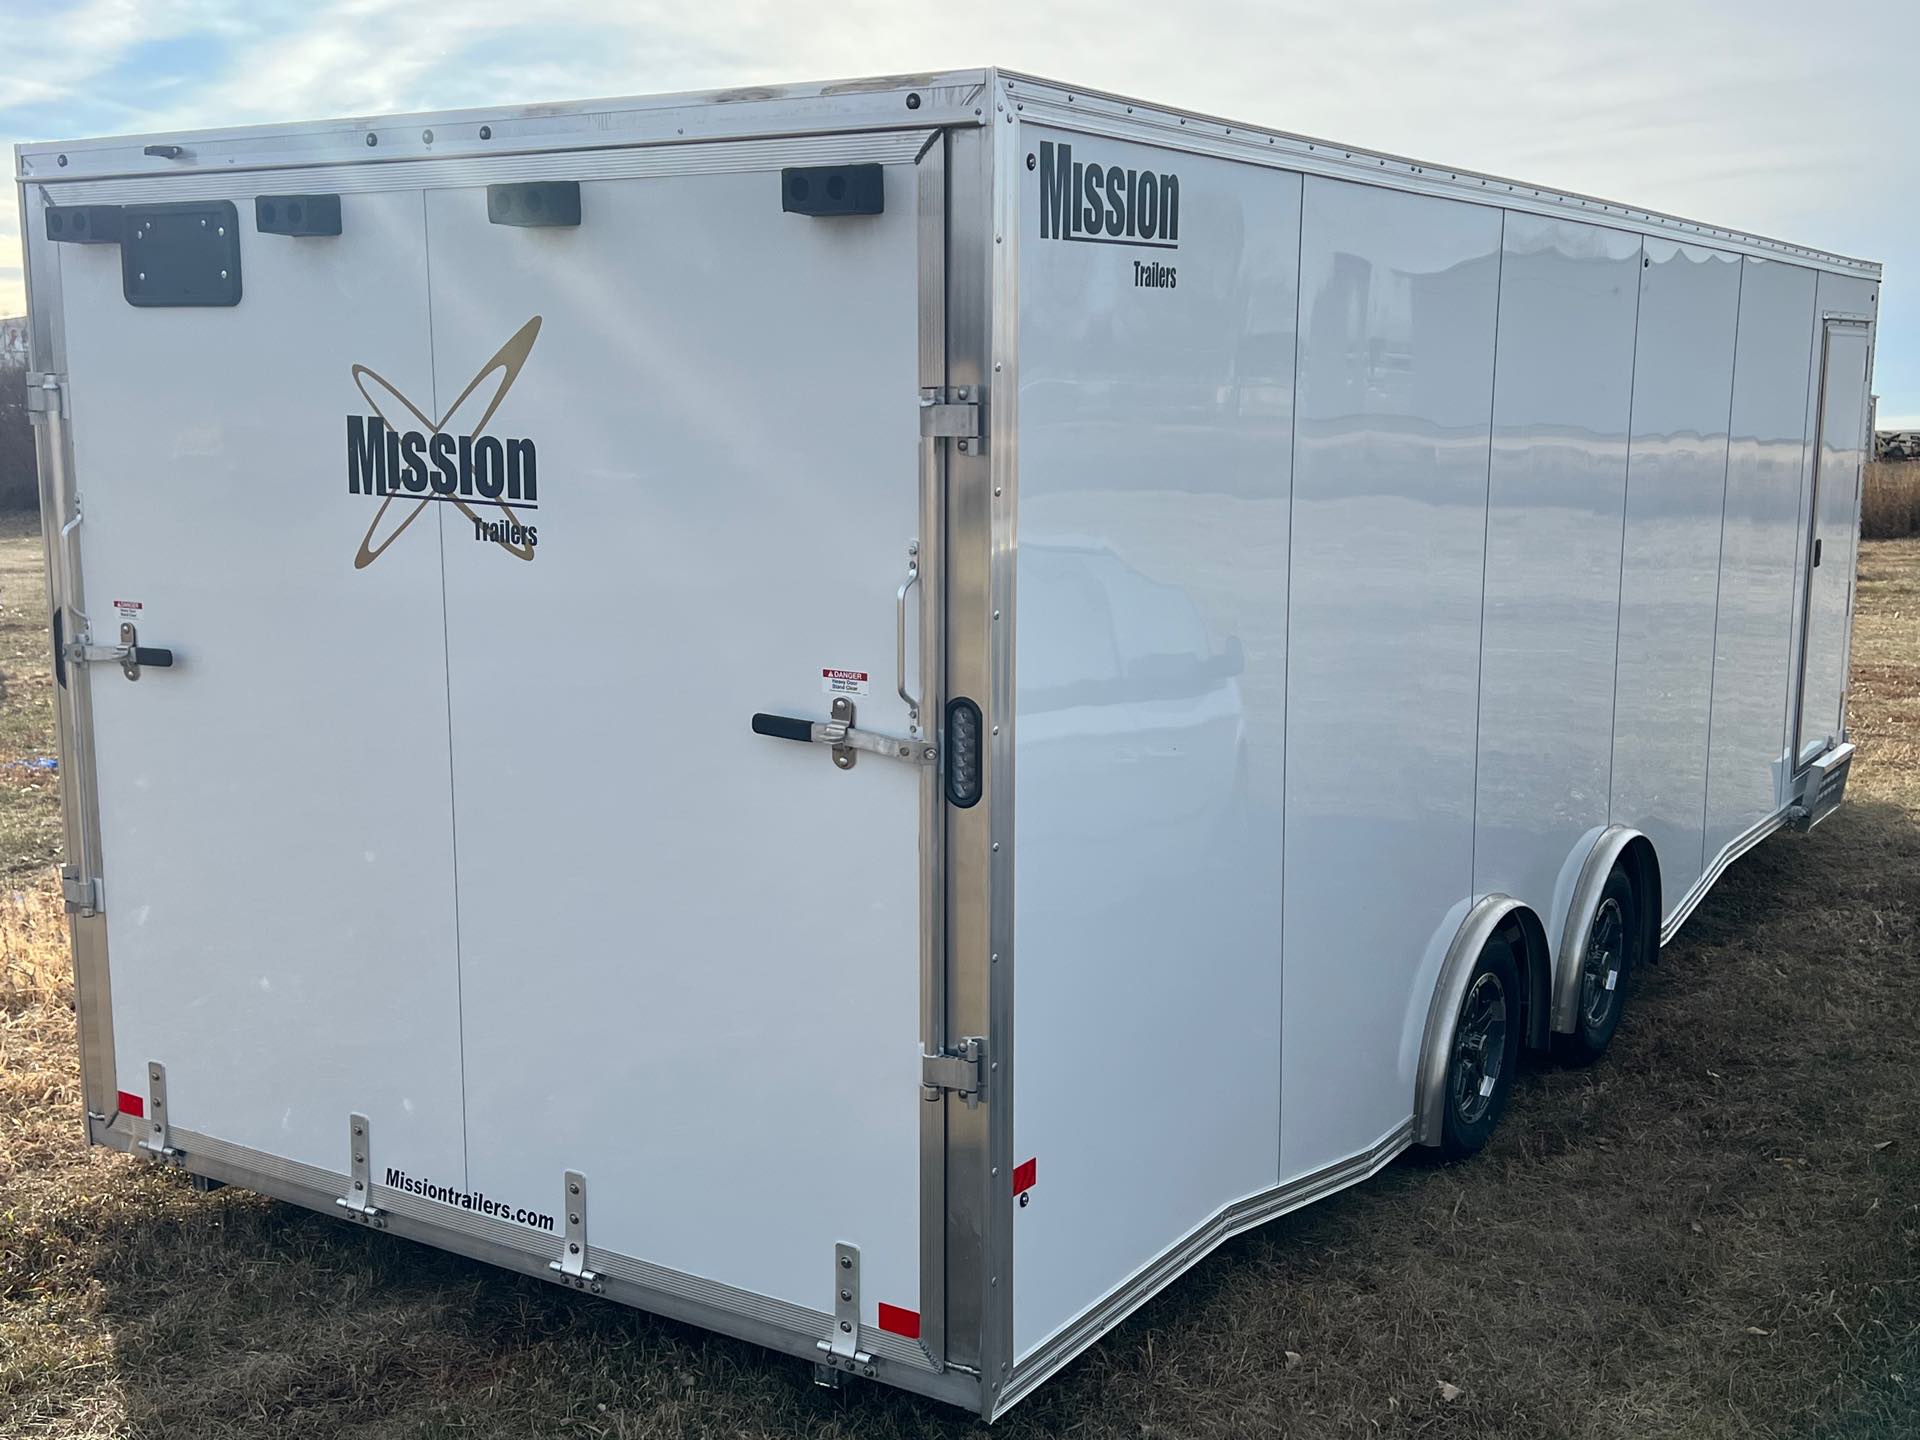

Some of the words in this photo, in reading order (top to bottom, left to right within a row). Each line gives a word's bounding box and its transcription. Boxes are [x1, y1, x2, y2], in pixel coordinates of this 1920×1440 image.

[1134, 261, 1177, 288] Trailers
[473, 517, 538, 547] Trailers
[834, 670, 863, 680] DANGER
[385, 1167, 554, 1231] Missiontrailers.com
